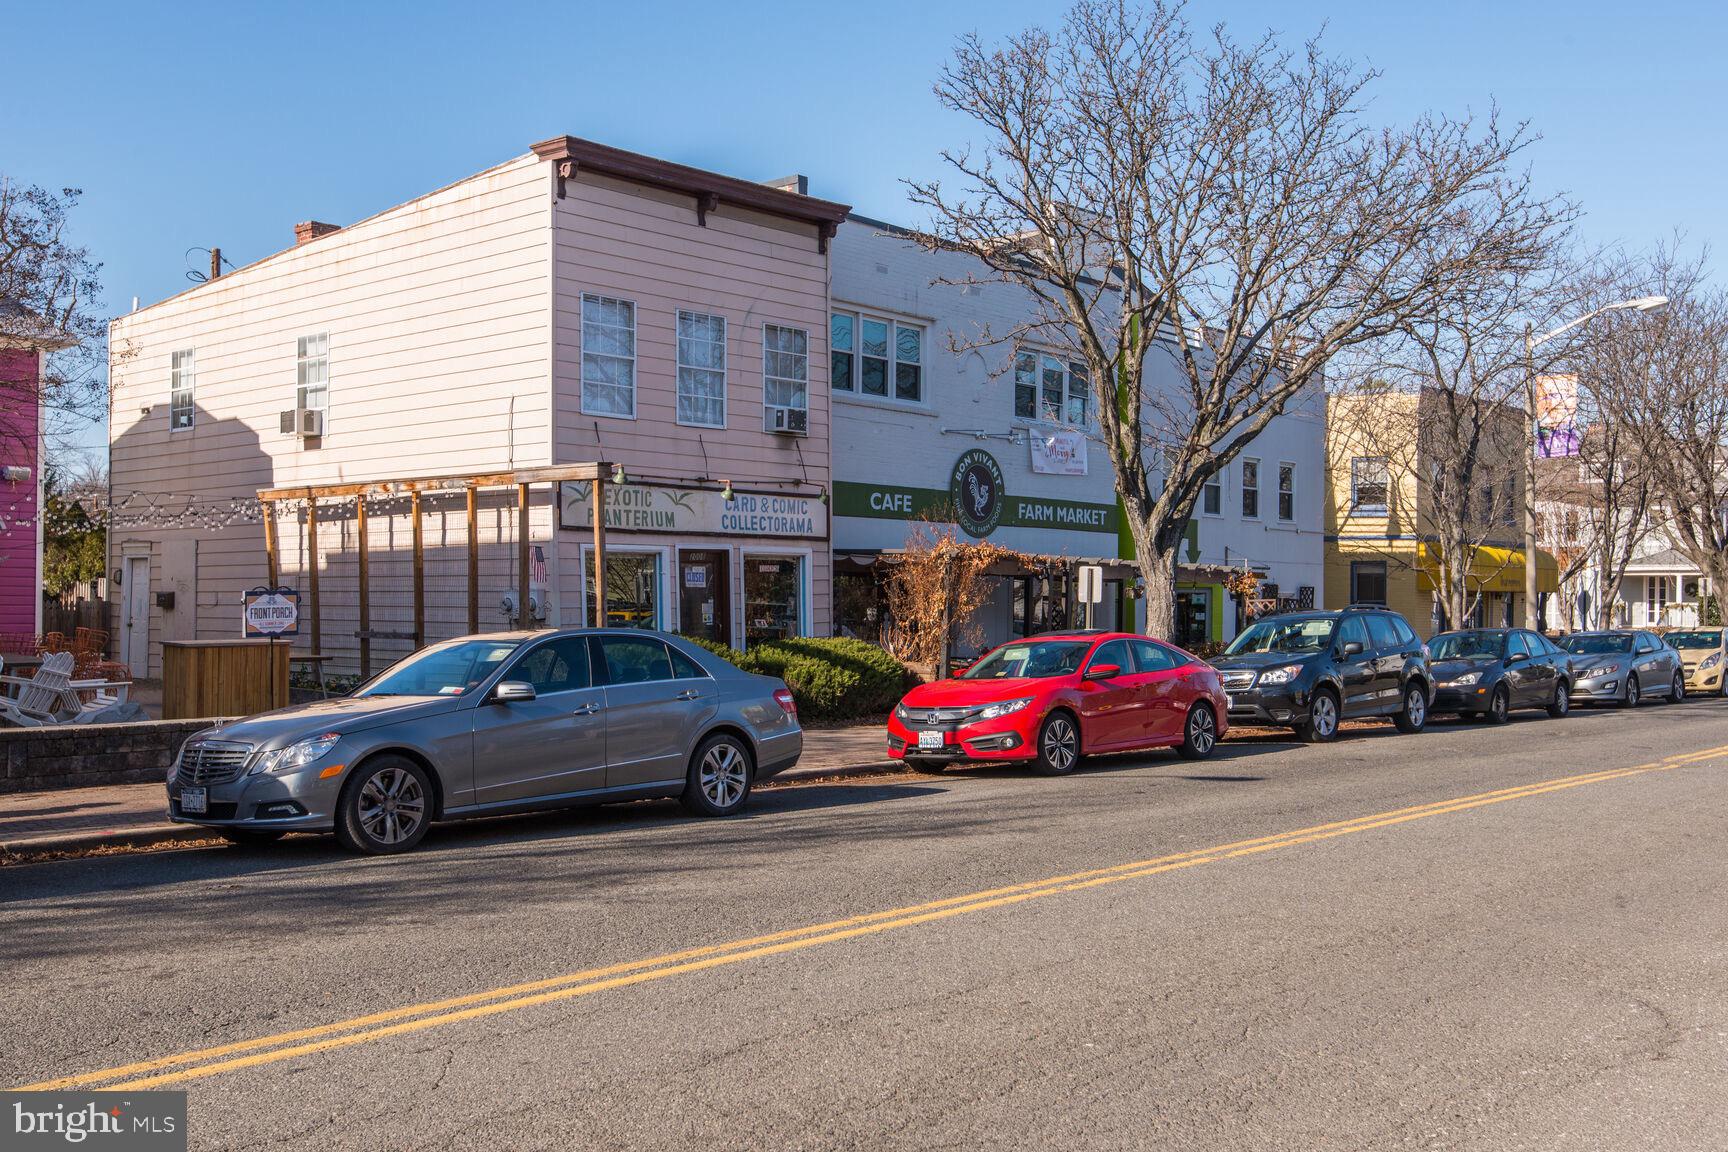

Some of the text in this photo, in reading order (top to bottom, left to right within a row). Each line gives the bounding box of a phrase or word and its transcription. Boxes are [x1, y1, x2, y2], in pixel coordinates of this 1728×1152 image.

[955, 452, 1002, 485] BON VIVANT
[605, 489, 652, 507] EXOTIC
[725, 496, 808, 515] CARD & COMIC
[870, 492, 912, 512] CAFE
[587, 508, 675, 528] PANTERIUM
[721, 514, 813, 533] COLLECTORAMA
[1018, 503, 1107, 525] FARM MARKET
[250, 606, 293, 620] FRONT PORCH
